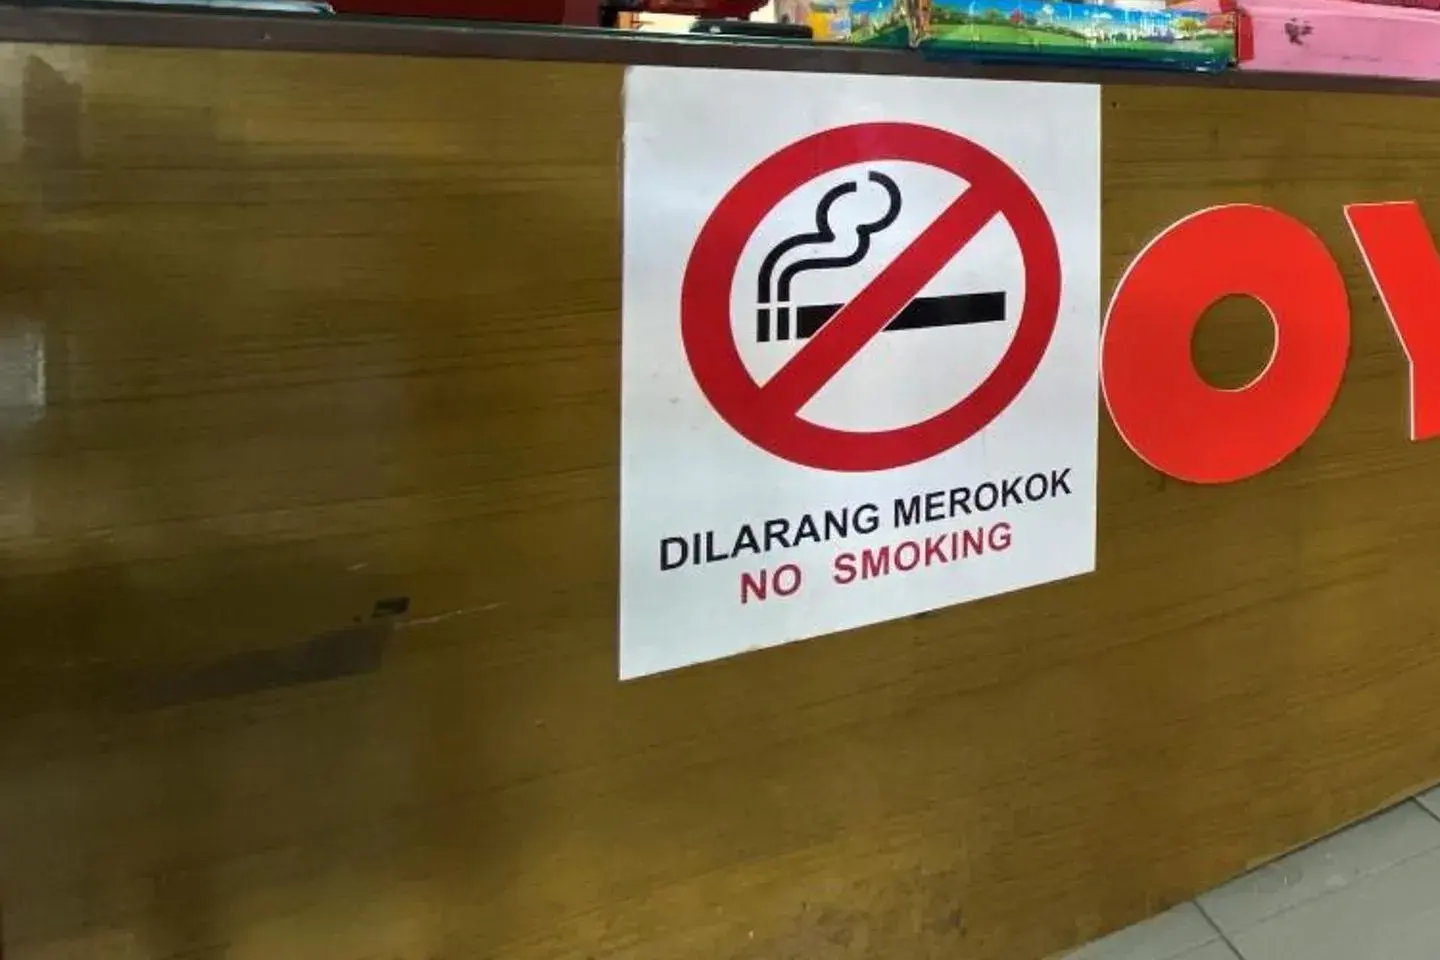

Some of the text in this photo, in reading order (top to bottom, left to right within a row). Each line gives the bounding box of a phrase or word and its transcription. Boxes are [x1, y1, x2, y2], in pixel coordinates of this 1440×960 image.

[659, 468, 1072, 571] DILARANG MEROKOK
[740, 522, 1013, 604] NO SMOKING
